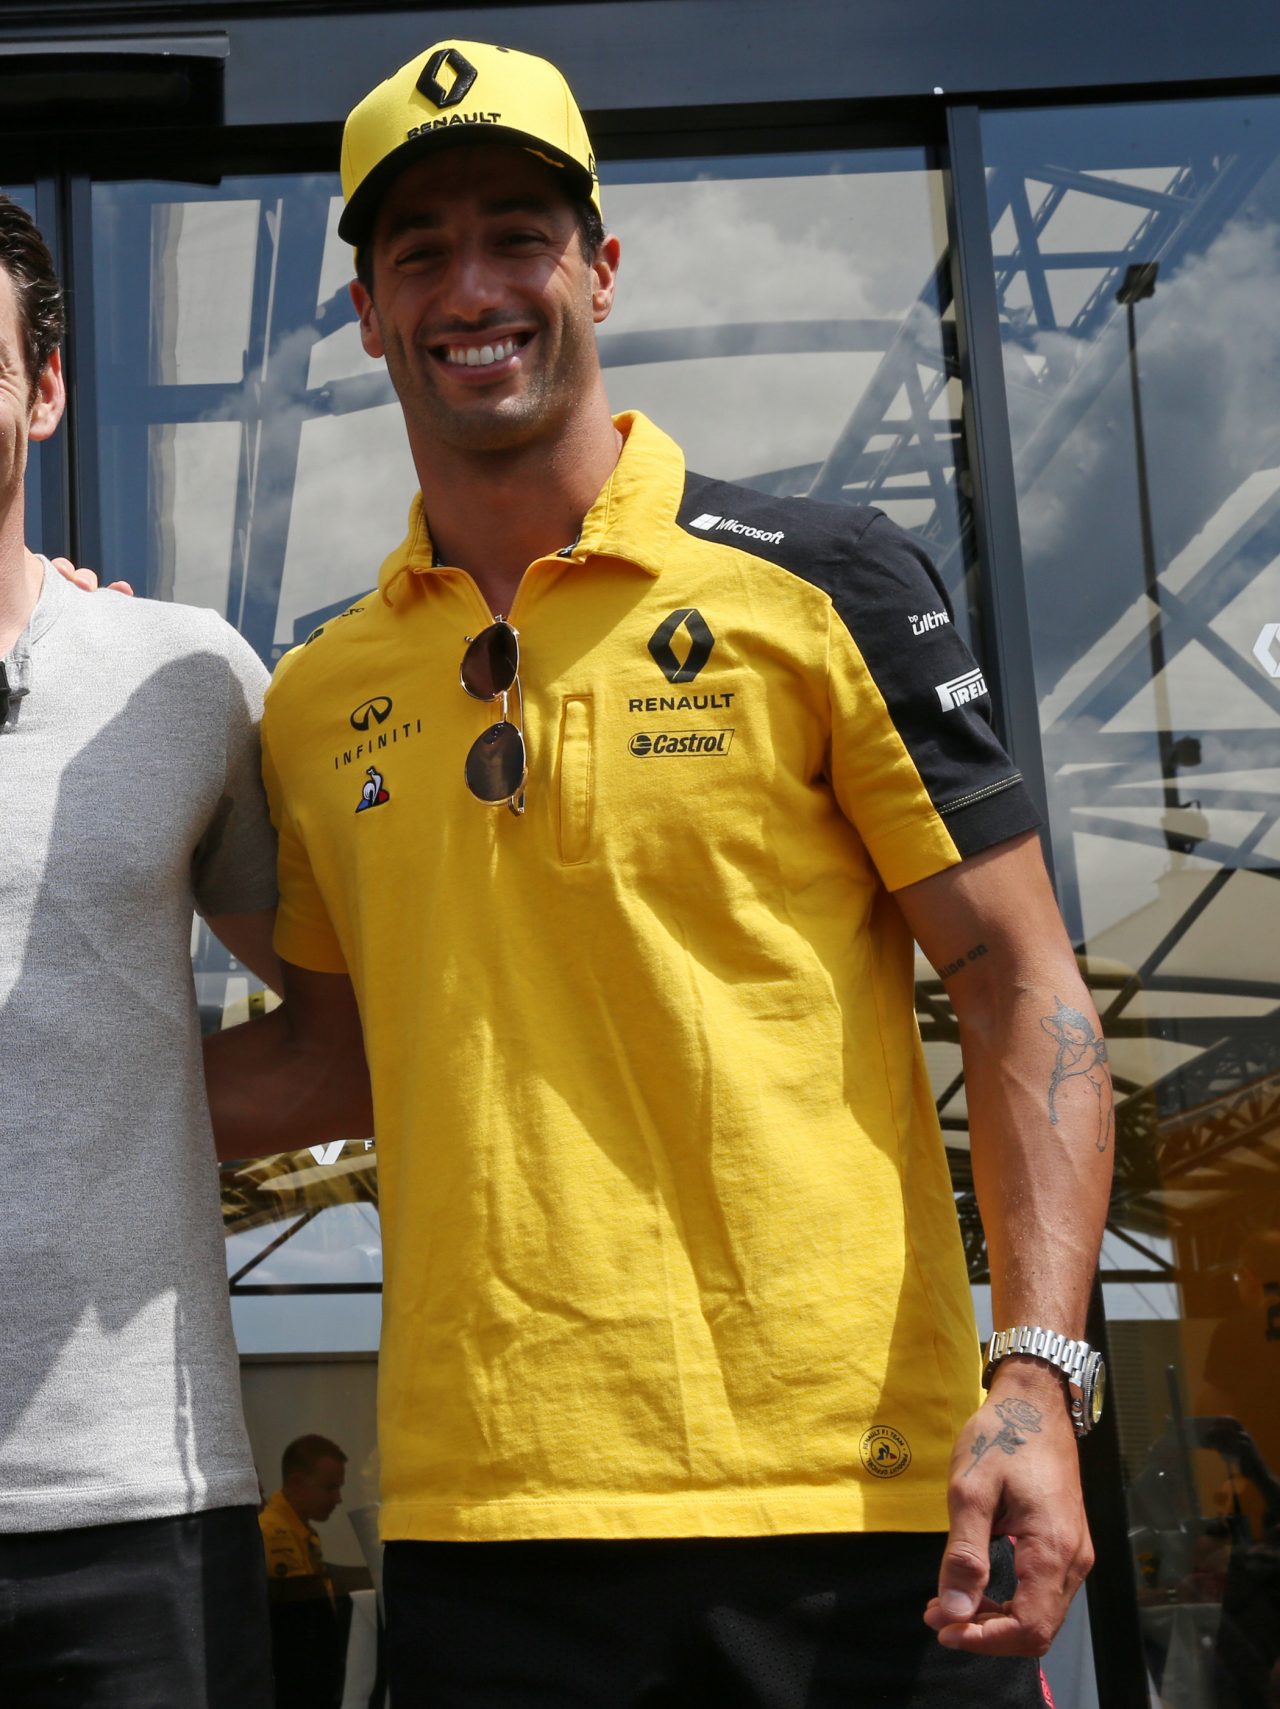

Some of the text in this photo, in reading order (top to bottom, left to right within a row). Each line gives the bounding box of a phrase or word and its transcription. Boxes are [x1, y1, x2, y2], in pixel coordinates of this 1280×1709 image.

[407, 111, 502, 141] RENAULT
[715, 518, 785, 545] Microsoft
[629, 693, 735, 713] RENAULT
[335, 719, 422, 770] INFINITI
[653, 733, 725, 754] Castrol
